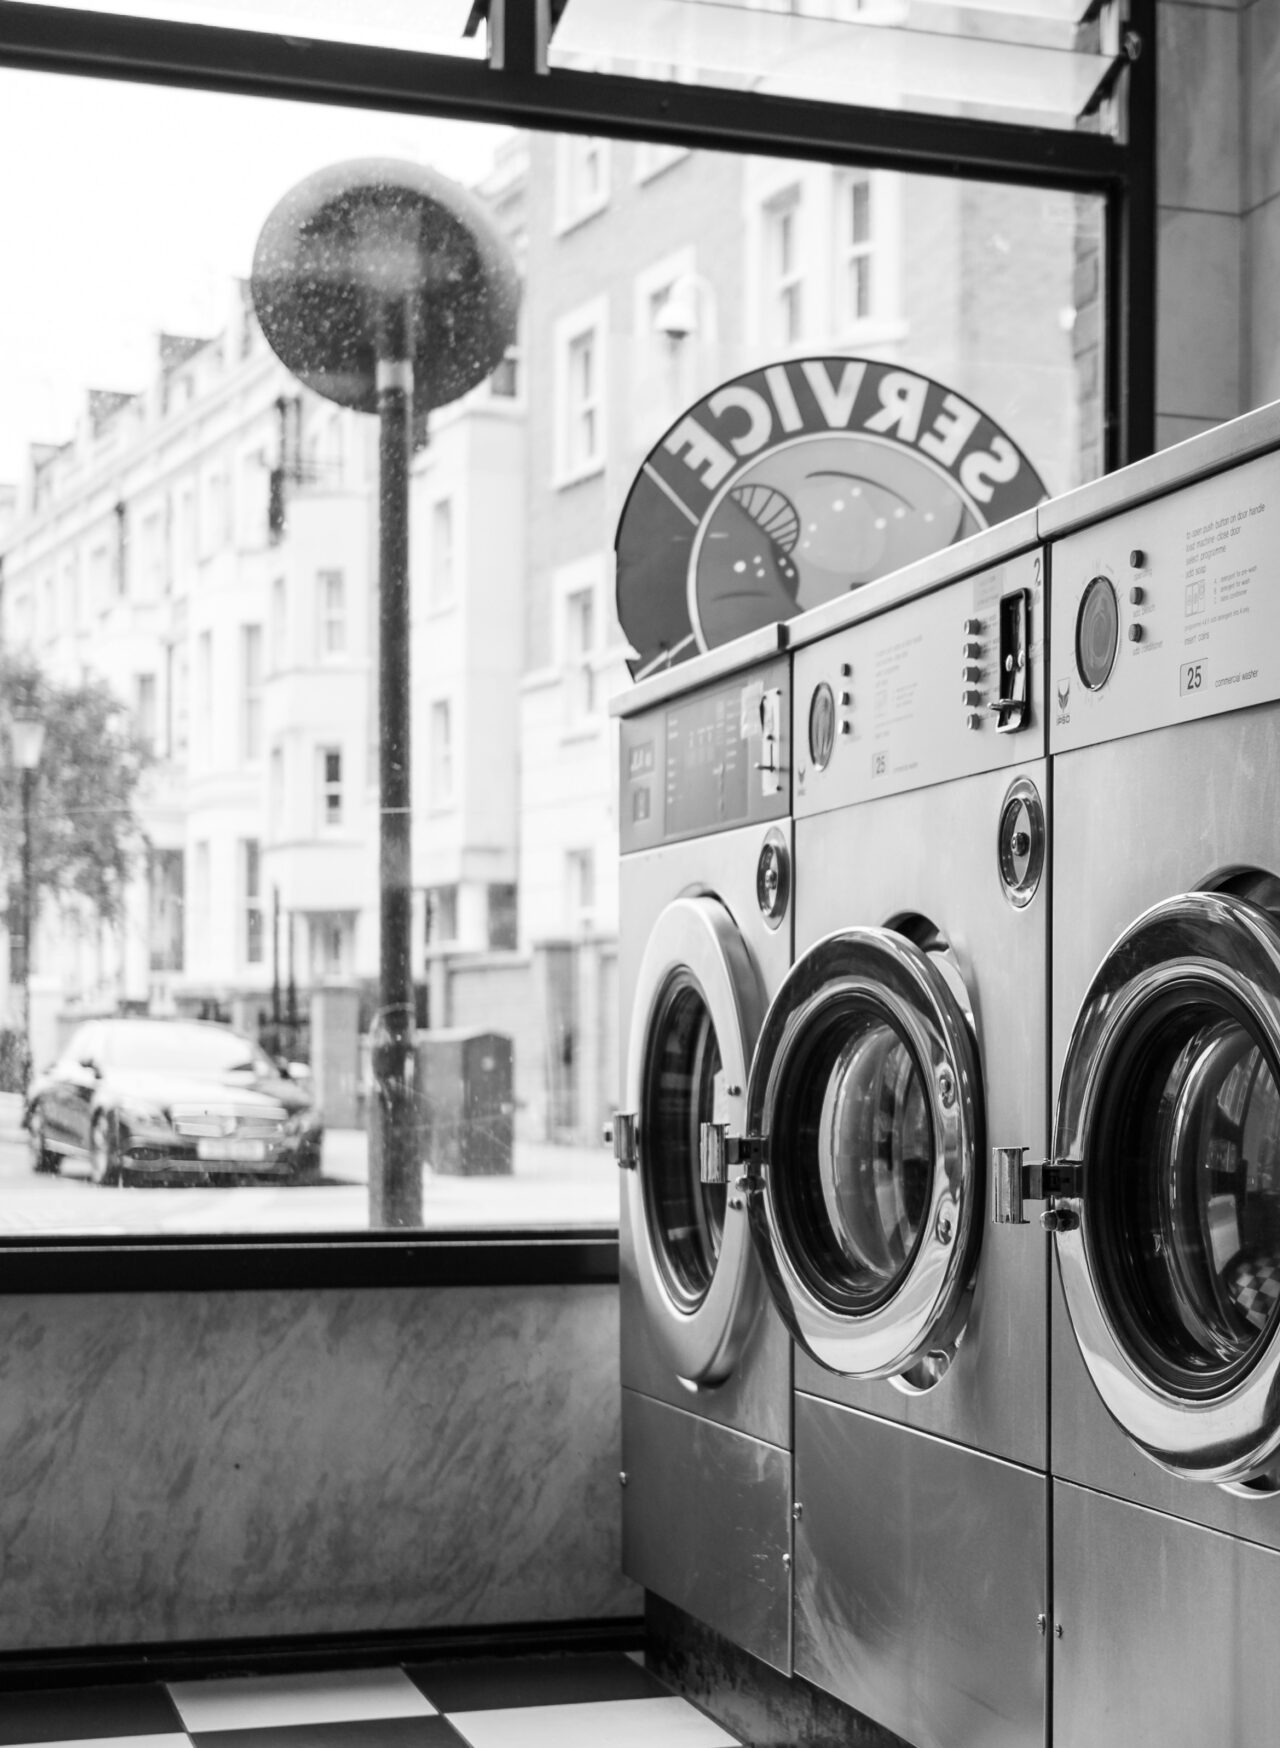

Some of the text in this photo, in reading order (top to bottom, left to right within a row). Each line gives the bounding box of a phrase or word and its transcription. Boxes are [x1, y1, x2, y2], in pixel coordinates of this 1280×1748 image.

[1033, 557, 1042, 587] 2
[1187, 665, 1202, 690] 25
[876, 755, 886, 775] 25
